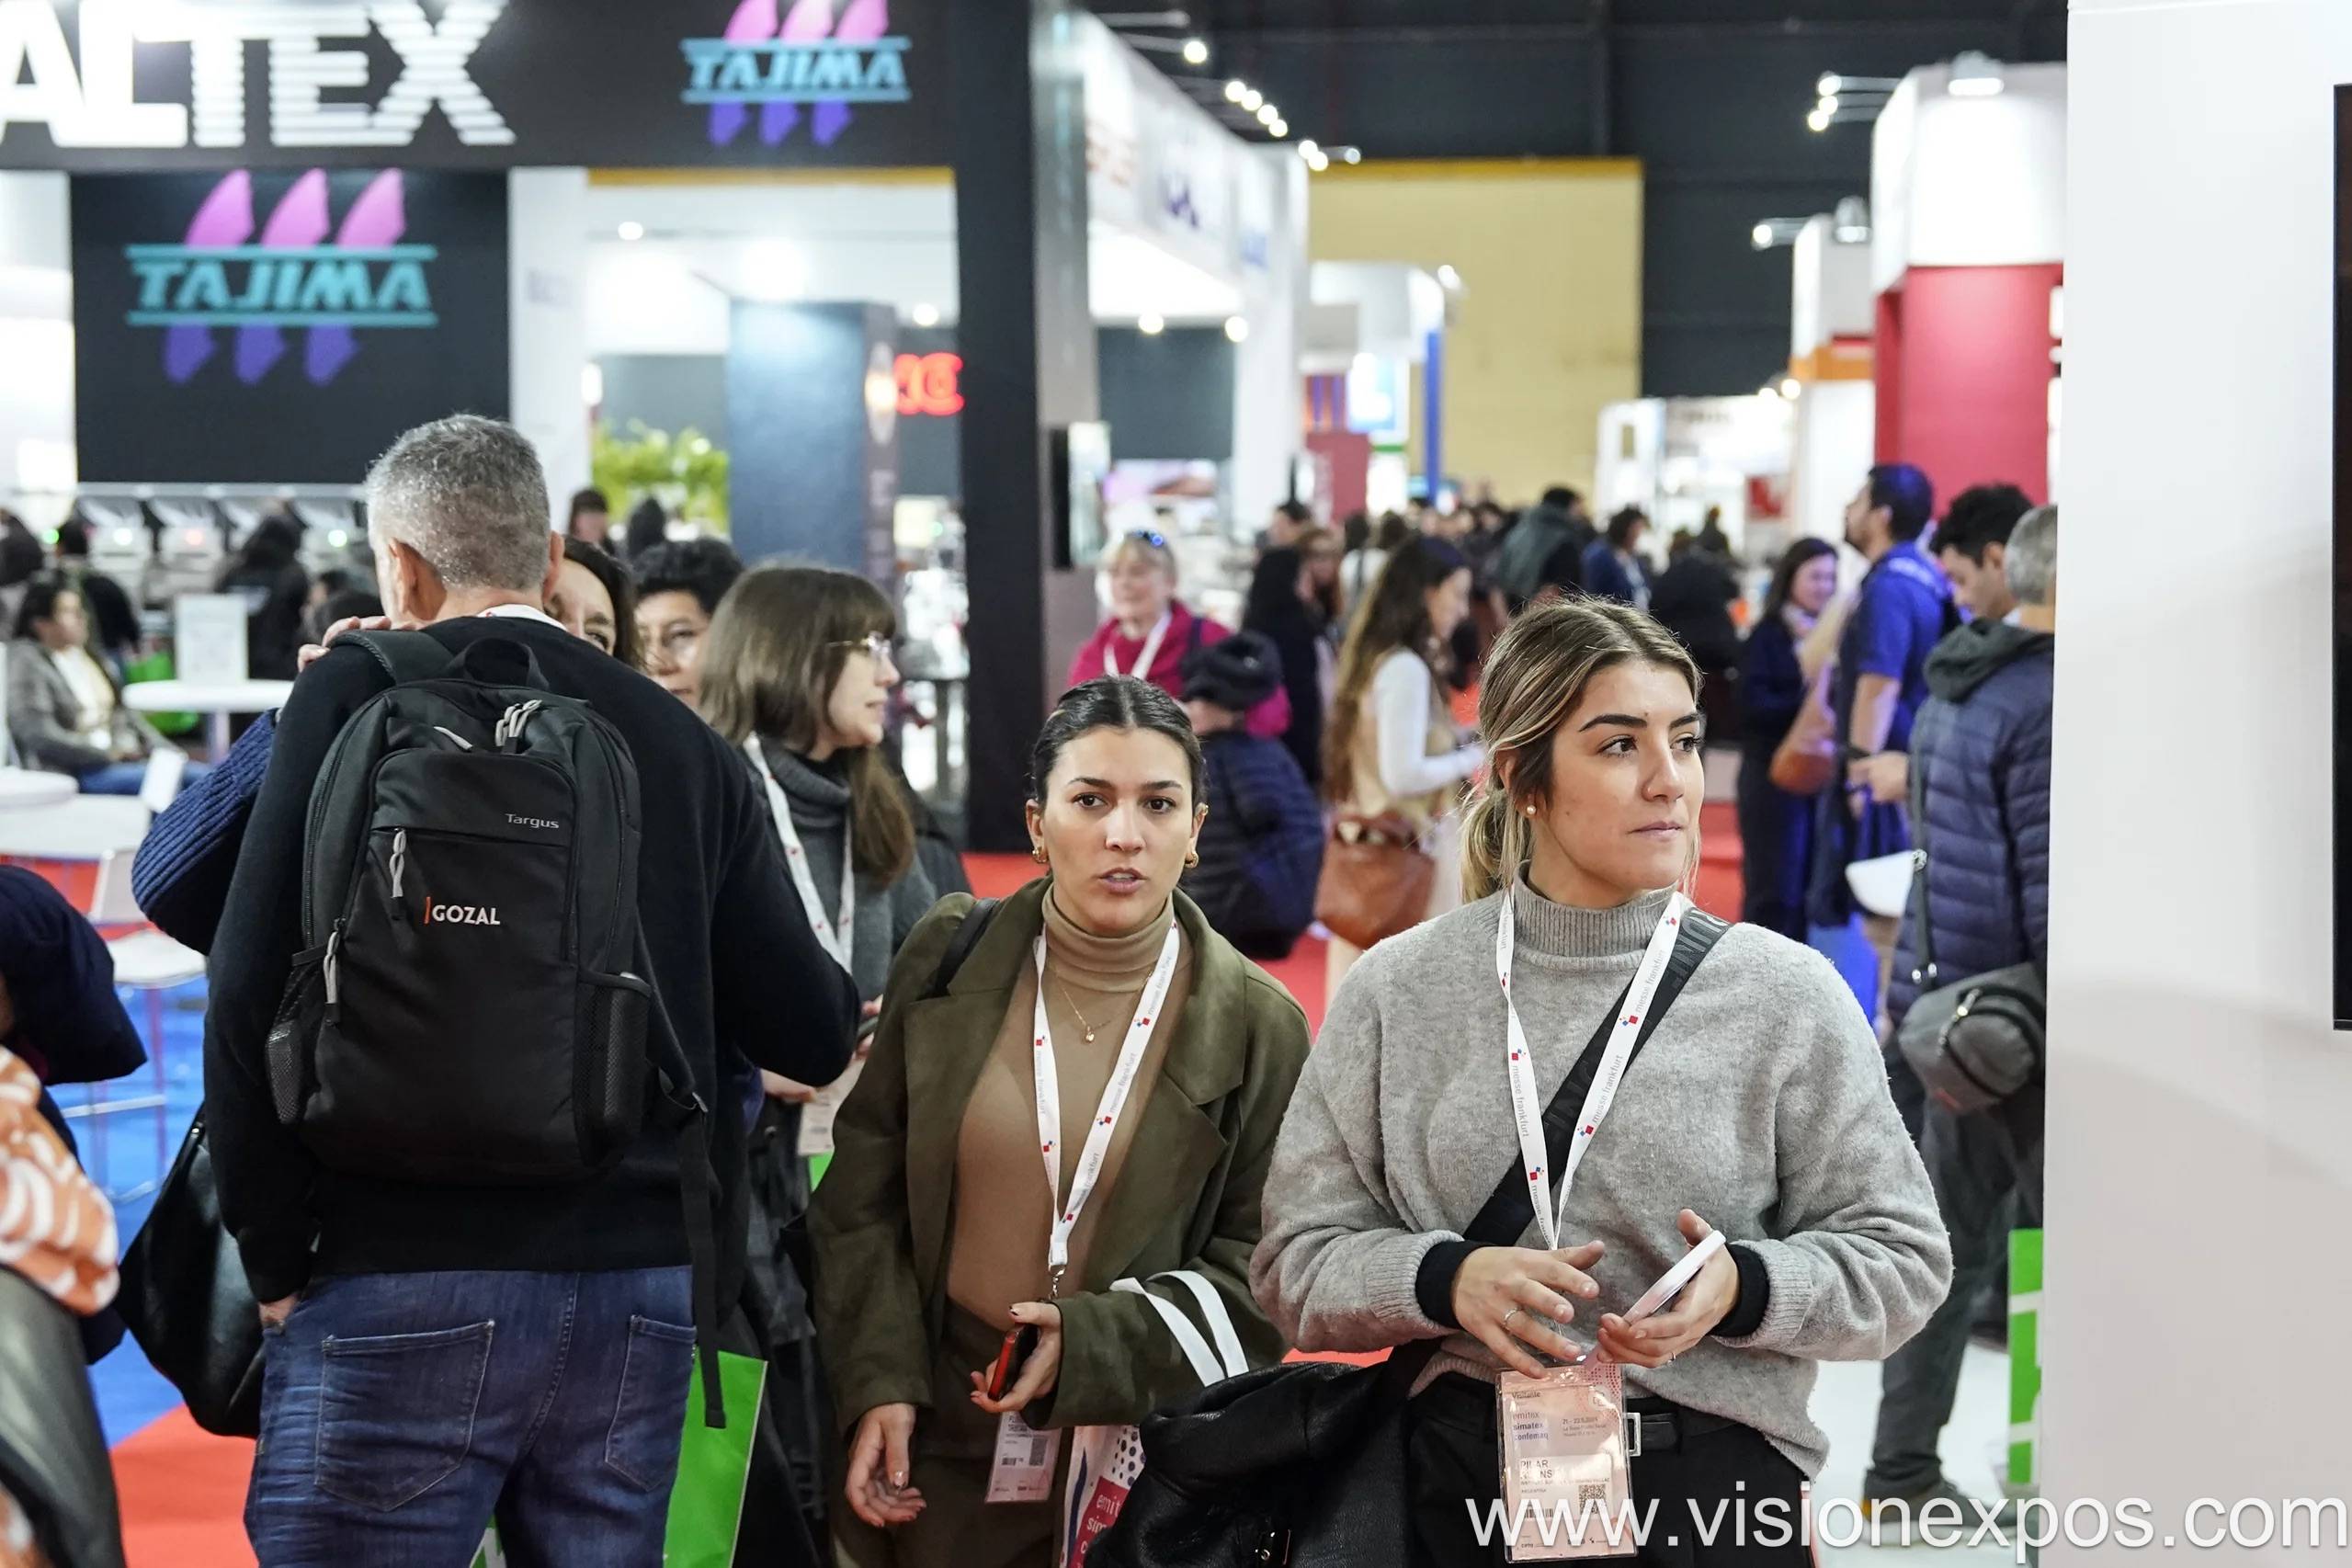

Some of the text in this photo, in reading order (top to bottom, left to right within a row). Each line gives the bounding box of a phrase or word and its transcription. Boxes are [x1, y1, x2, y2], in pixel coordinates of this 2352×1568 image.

[683, 49, 906, 90] TAJIMA
[131, 258, 431, 310] TAJIMA
[505, 813, 560, 829] Targus
[431, 904, 501, 926] GOZAL
[1118, 1051, 1136, 1086] frankfurt
[1512, 1065, 1530, 1138] messe frankfurt
[1592, 1054, 1624, 1124] messe frankfurt
[1513, 1421, 1544, 1431] simatex
